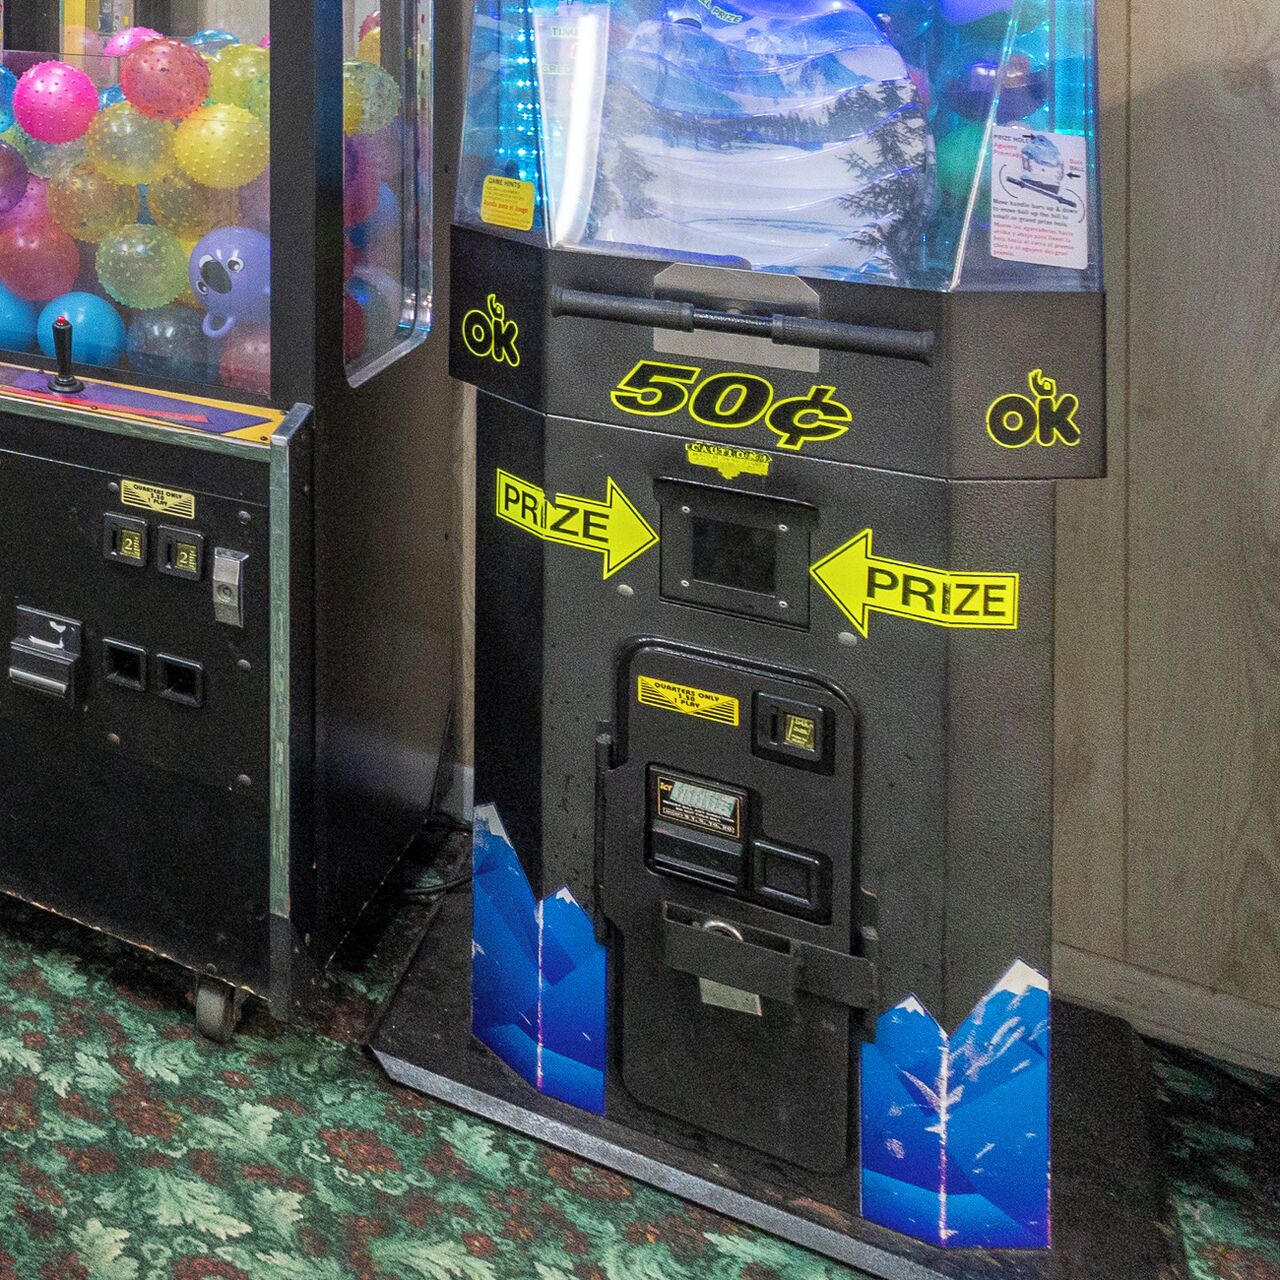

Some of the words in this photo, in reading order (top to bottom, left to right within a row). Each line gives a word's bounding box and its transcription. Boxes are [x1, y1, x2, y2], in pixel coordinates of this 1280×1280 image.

[713, 7, 743, 23] PRIZE
[611, 361, 853, 449] 50¢
[986, 382, 1081, 449] OK
[133, 484, 164, 495] QUARTERS
[166, 491, 182, 499] ONLY
[504, 483, 610, 543] PRIZE
[866, 568, 1007, 617] PRIZE
[654, 682, 696, 697] QUARTERS
[698, 693, 720, 702] ONLY
[681, 700, 700, 708] PLAY
